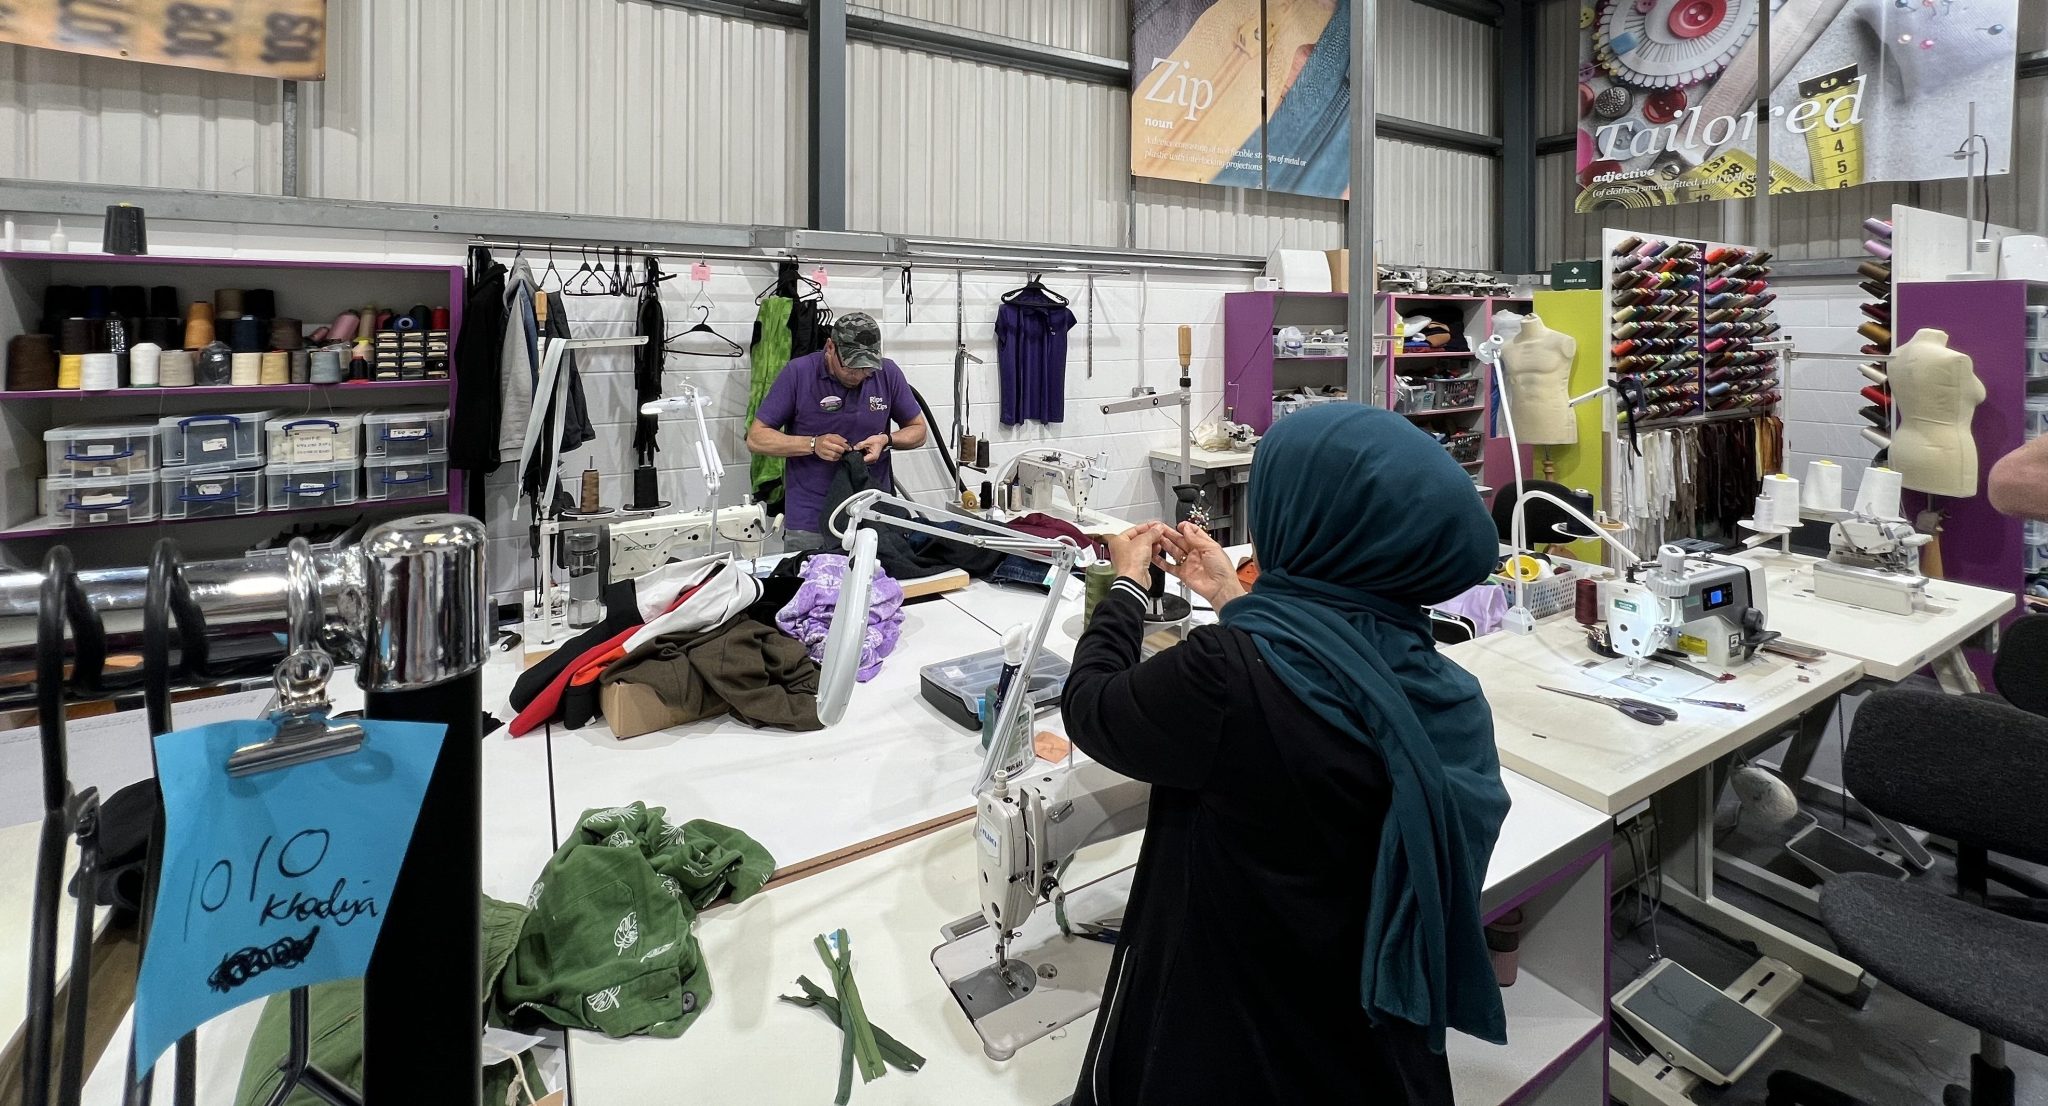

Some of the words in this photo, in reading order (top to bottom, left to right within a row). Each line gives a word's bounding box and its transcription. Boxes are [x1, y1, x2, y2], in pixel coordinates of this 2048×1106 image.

[1144, 57, 1214, 121] Zip
[1144, 117, 1174, 129] noun
[1593, 74, 1868, 163] Tailored
[1834, 138, 1844, 153] 4
[1225, 160, 1263, 171] projections
[1277, 154, 1285, 165] of
[1284, 157, 1300, 166] metal
[1702, 155, 1727, 173] 137
[1837, 159, 1848, 174] 5
[1592, 168, 1655, 183] adjective
[1592, 189, 1605, 198] (of
[1606, 184, 1640, 196] clothes)
[1672, 178, 1700, 191] fitted,
